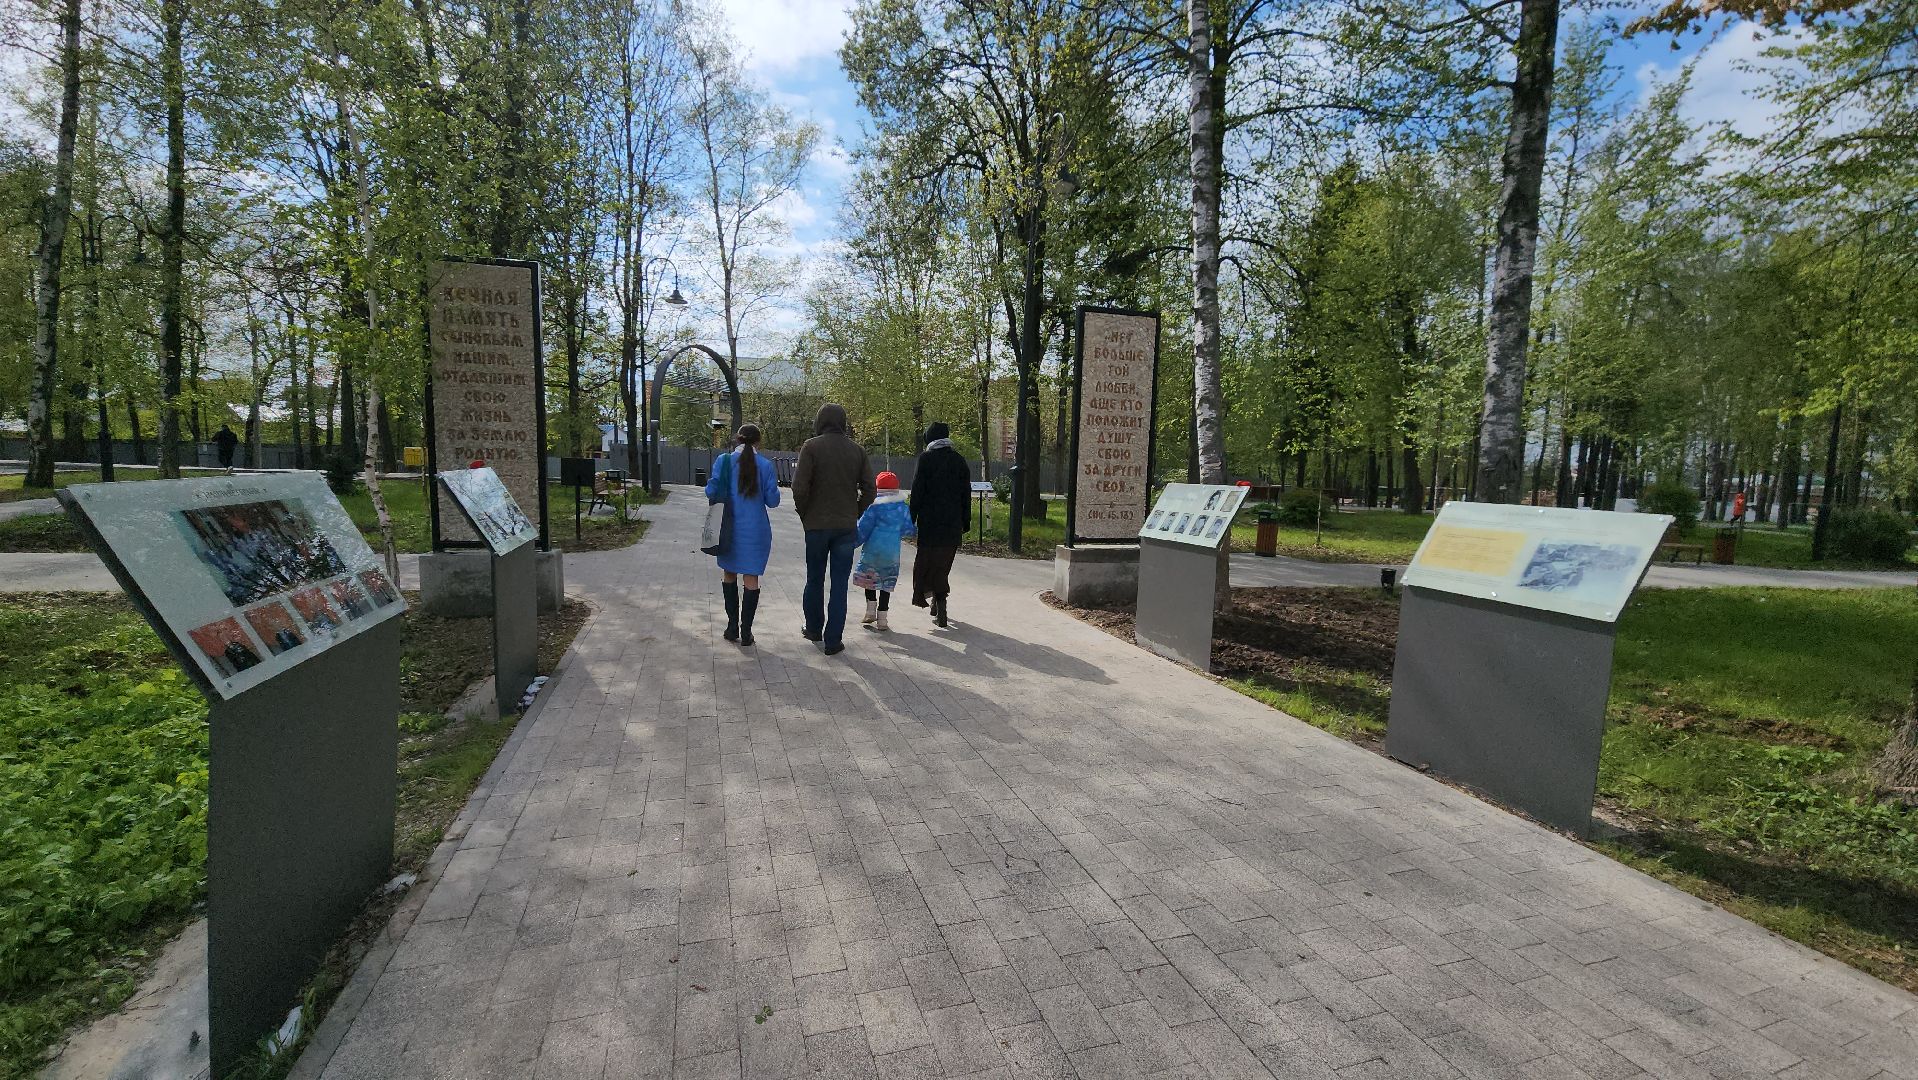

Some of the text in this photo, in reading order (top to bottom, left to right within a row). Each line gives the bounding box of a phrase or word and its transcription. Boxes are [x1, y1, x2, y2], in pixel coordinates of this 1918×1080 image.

[1094, 346, 1145, 361] БОЛЬШЕ
[1107, 363, 1130, 377] ТОЙ
[442, 370, 526, 385] ОТДАВШИМ
[464, 391, 506, 403] СВОЮ
[1089, 398, 1143, 411] АЩЕ КТО
[461, 410, 512, 422] ЖИЗНЬ
[1086, 413, 1144, 428] ПОЛОЖИТ
[446, 428, 527, 442] ЗА ЗЕМЛЮ
[1097, 431, 1136, 444] ДУШУ
[1097, 447, 1131, 460] СВОЮ
[1084, 463, 1142, 478] ЗА ДРУГИ
